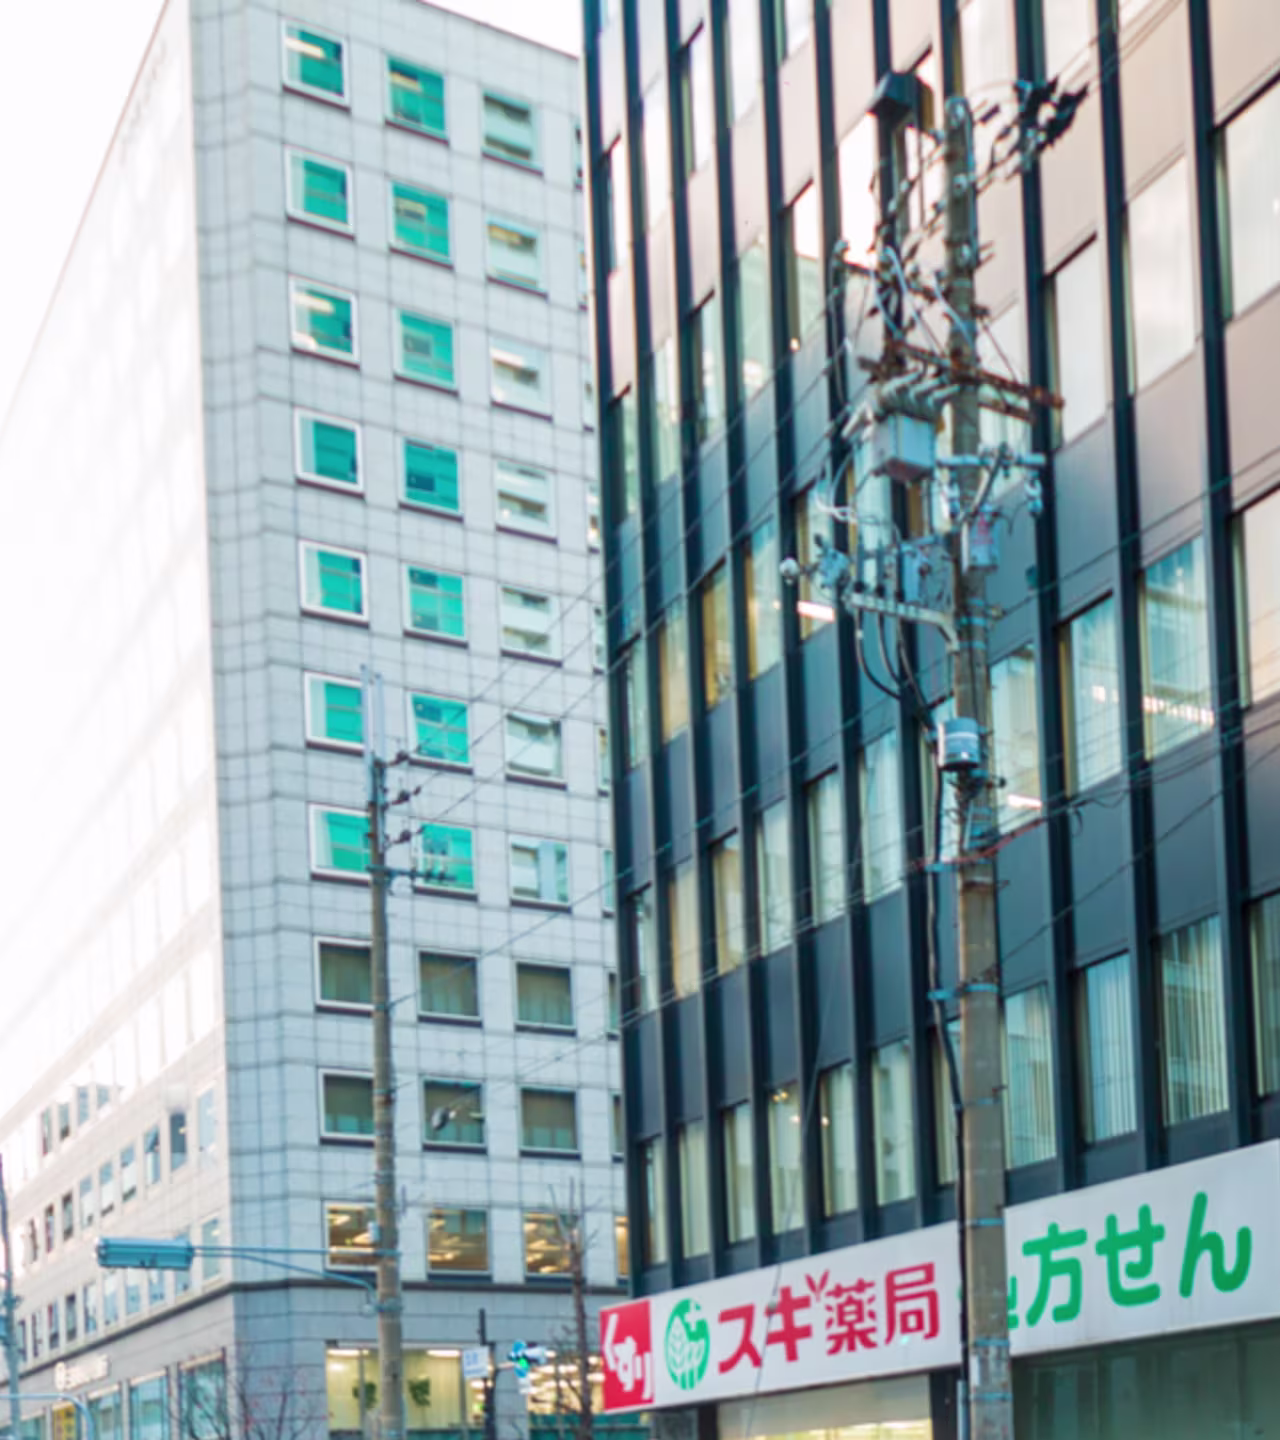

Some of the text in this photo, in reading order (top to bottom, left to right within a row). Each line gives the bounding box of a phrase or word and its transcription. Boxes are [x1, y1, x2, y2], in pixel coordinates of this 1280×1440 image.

[1003, 1192, 1252, 1330] 方せん
[604, 1313, 651, 1399] くすり
[718, 1262, 940, 1374] スギ薬局
